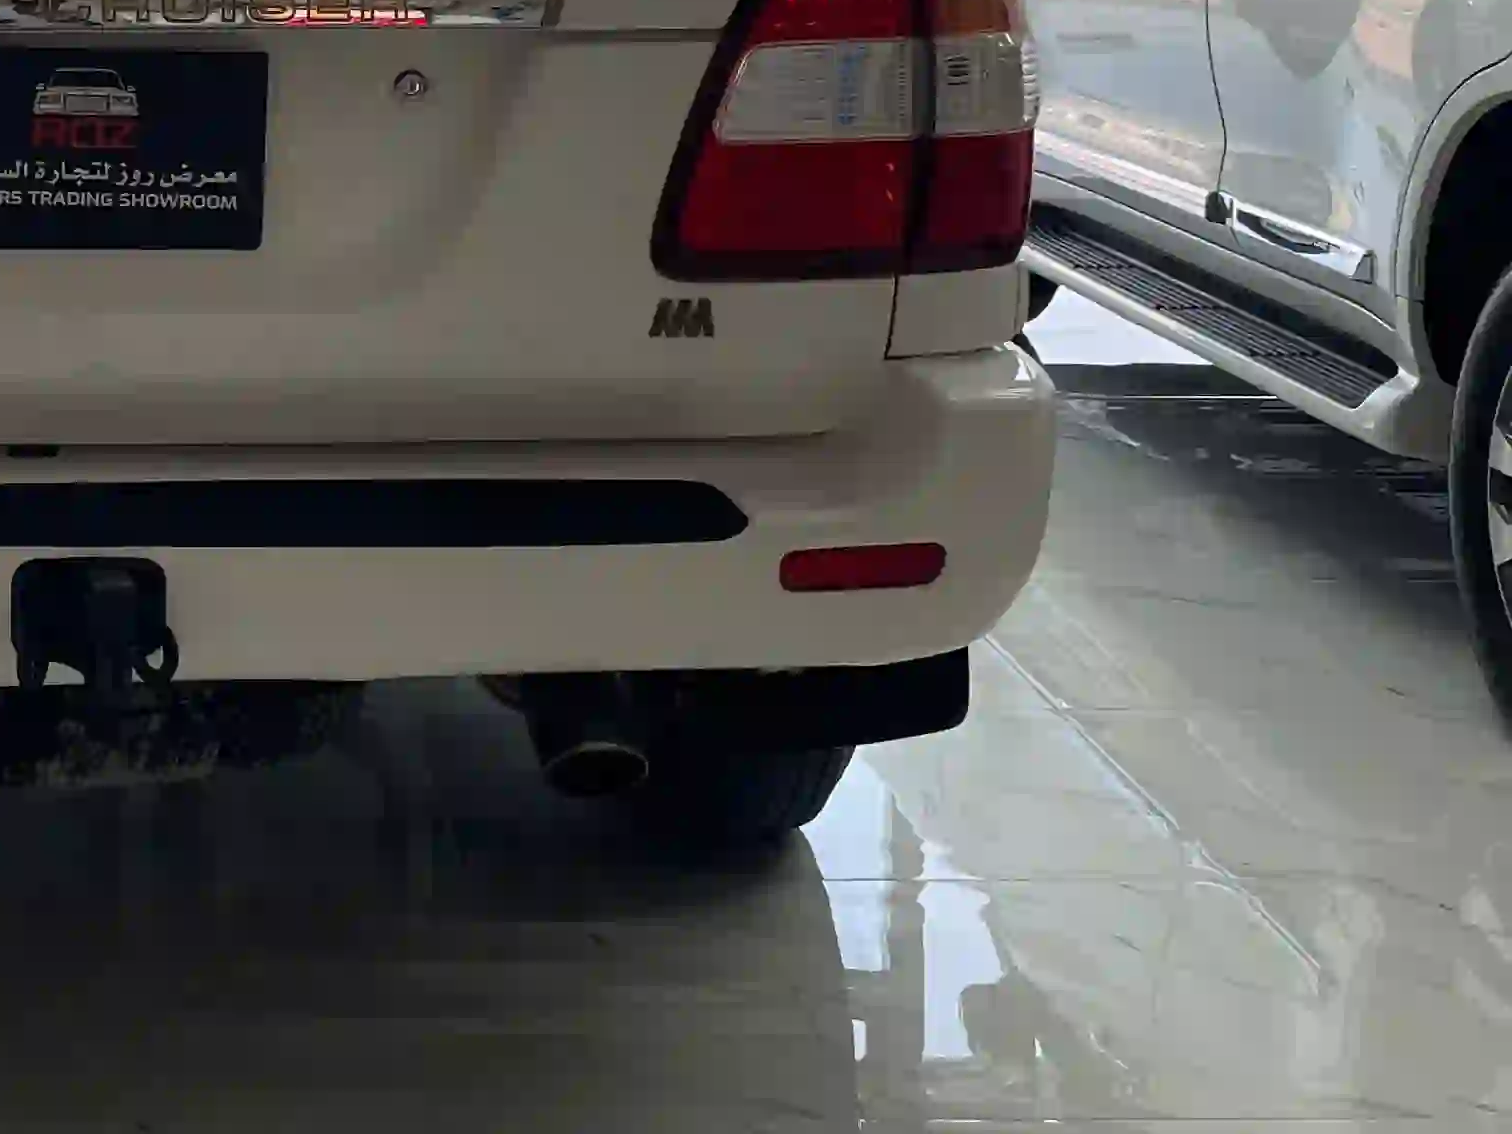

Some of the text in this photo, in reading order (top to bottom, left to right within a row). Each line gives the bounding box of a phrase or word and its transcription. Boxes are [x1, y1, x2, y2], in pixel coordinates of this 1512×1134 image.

[34, 160, 112, 187] لتجارة
[114, 161, 156, 187] روز
[159, 162, 238, 189] معرض
[28, 190, 114, 208] TRADING
[119, 191, 238, 211] SHOWROOM
